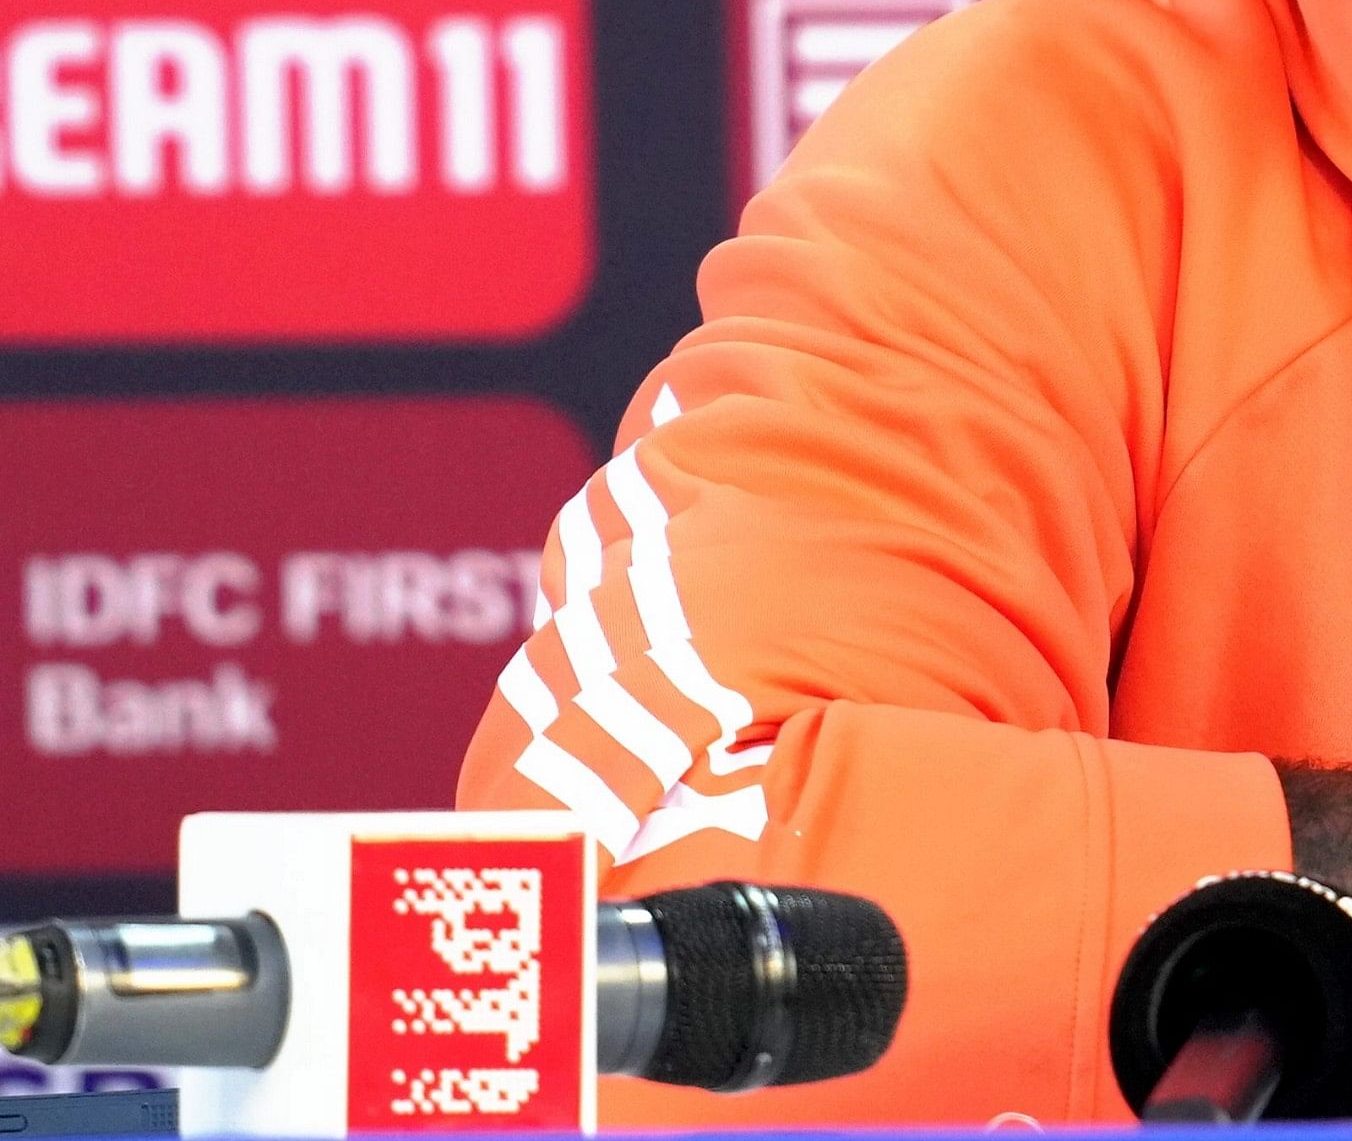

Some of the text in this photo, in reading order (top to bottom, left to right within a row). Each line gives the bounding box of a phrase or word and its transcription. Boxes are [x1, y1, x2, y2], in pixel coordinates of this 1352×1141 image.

[0, 15, 568, 198] EAM11
[22, 549, 262, 646] IDFC
[24, 661, 279, 757] Bank
